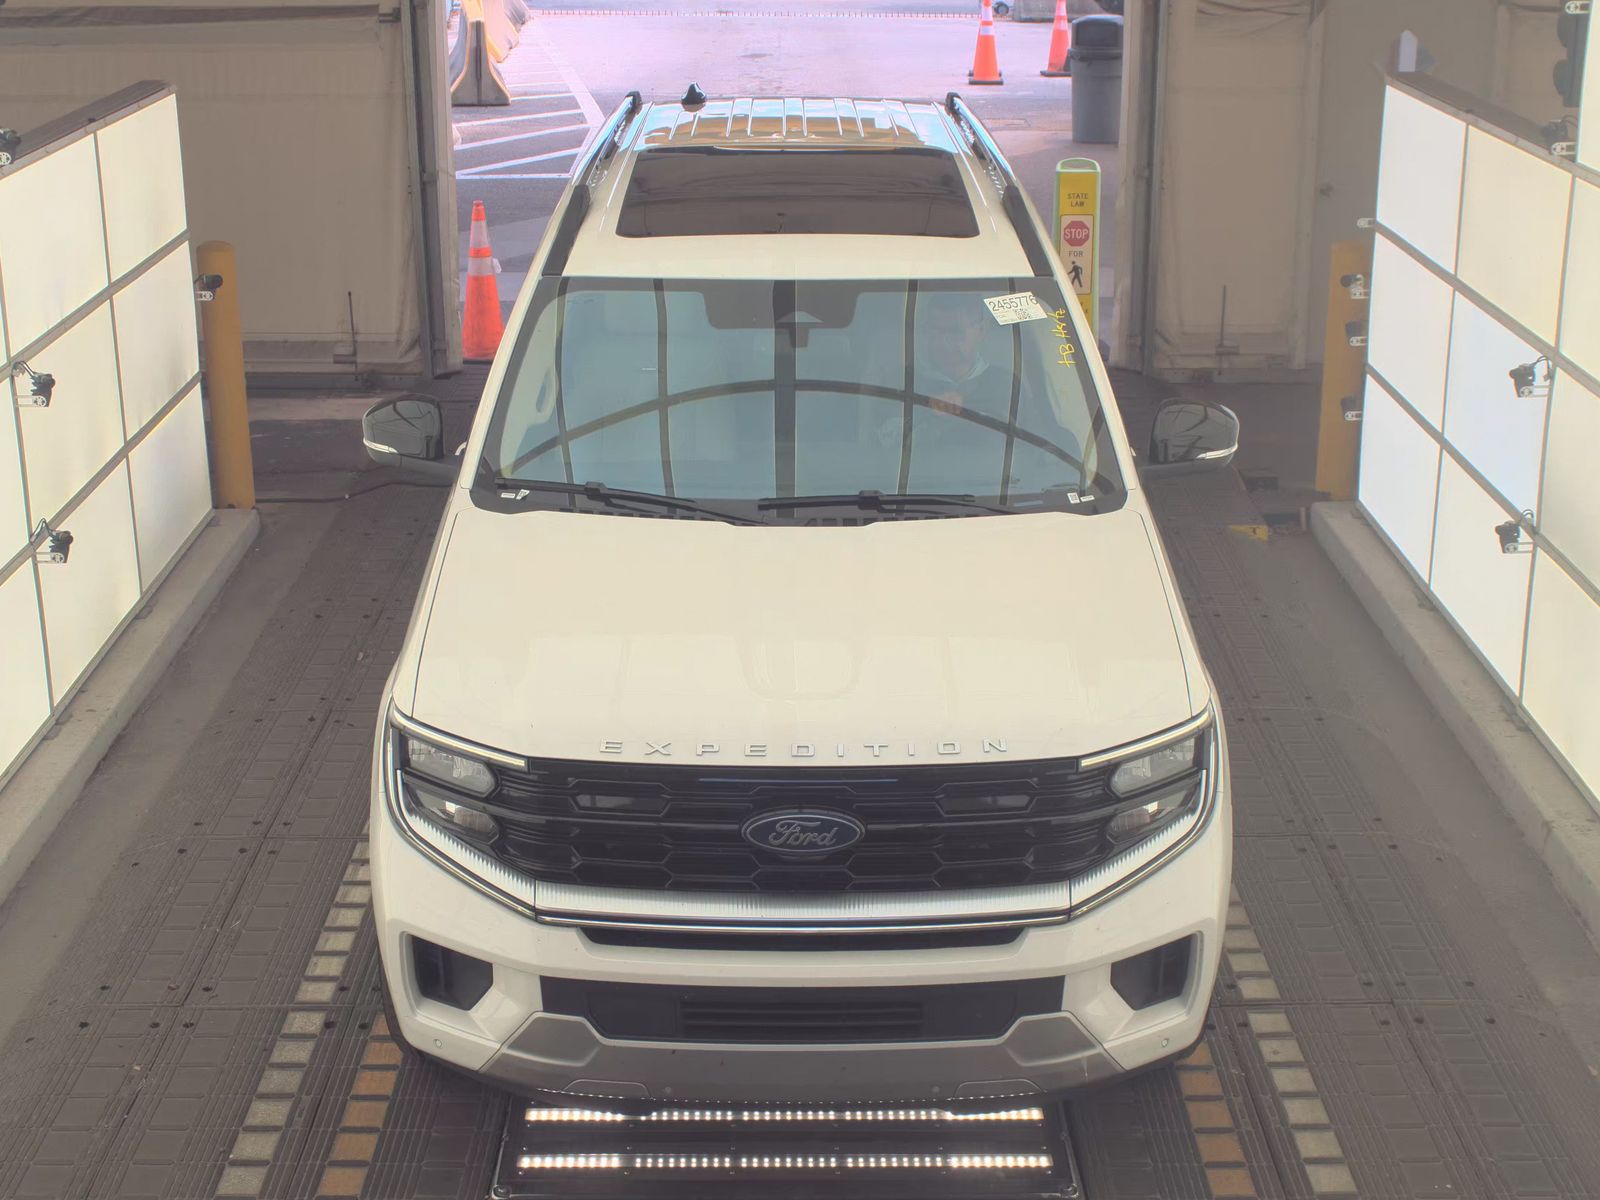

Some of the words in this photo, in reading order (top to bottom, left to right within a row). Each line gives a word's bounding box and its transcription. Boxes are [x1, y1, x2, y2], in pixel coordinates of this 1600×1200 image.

[1064, 228, 1089, 239] STOP
[988, 294, 1039, 312] 2455776
[599, 738, 1008, 758] EXPEDITION
[768, 819, 839, 846] Ford
